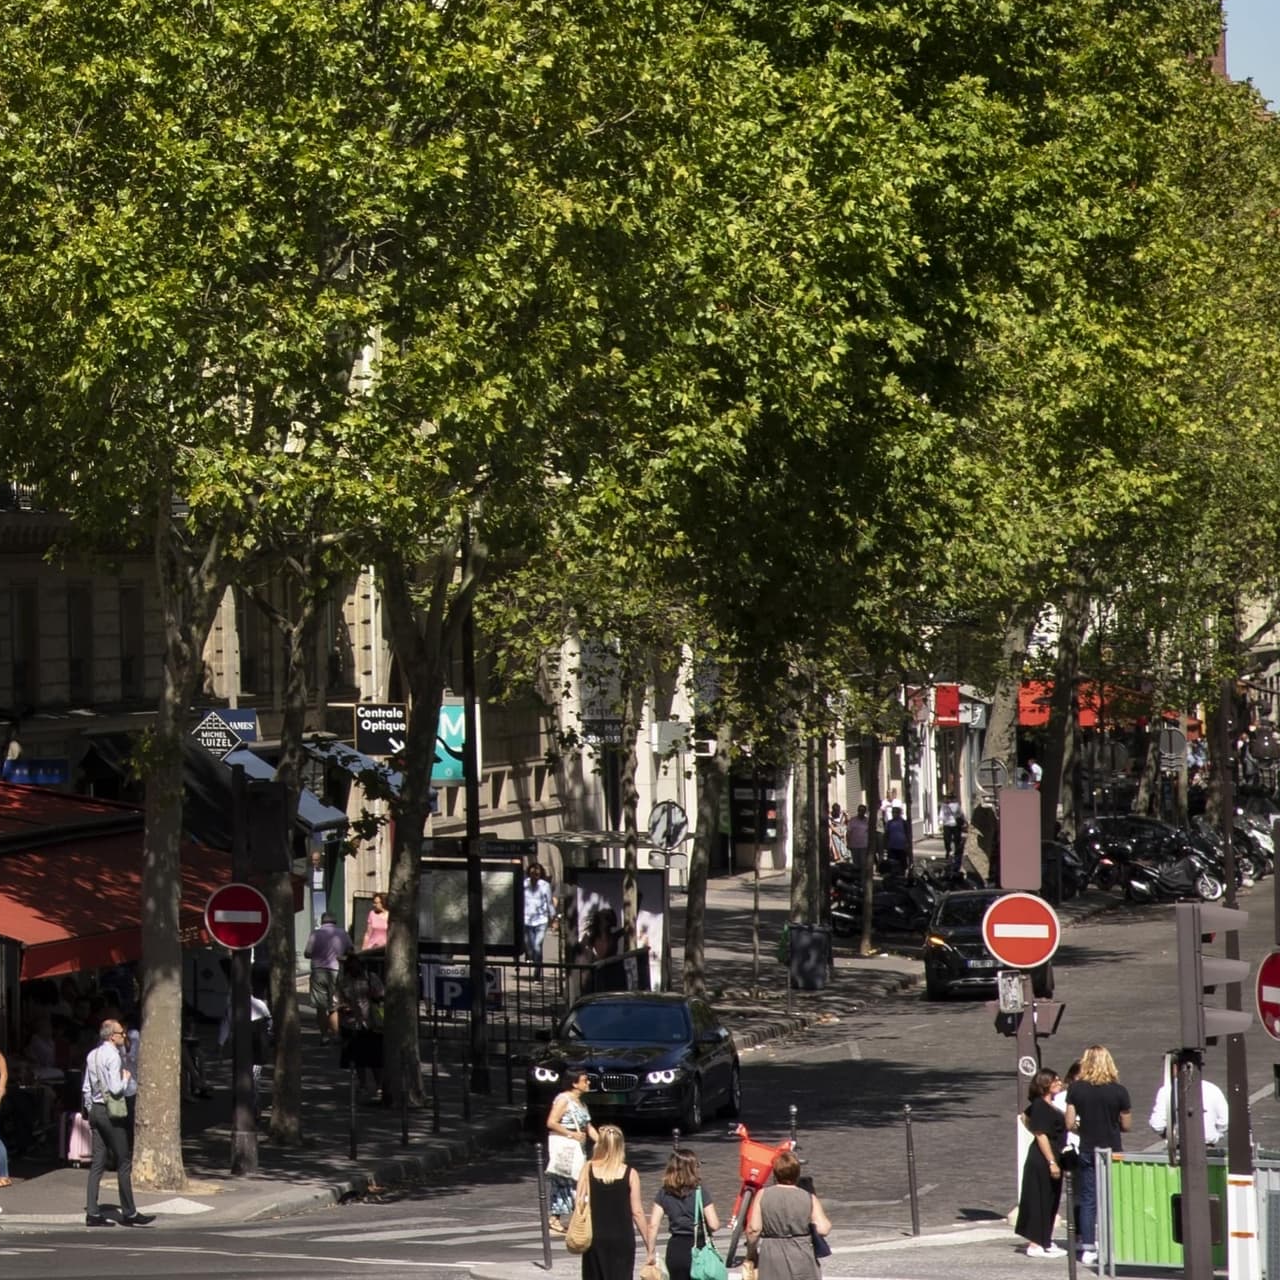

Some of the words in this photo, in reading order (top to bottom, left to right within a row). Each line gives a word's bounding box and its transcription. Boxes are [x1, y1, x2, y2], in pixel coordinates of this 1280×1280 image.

[357, 707, 403, 718] Centrale
[361, 720, 406, 733] Optique
[440, 712, 465, 741] M
[197, 738, 233, 747] LUIZEL
